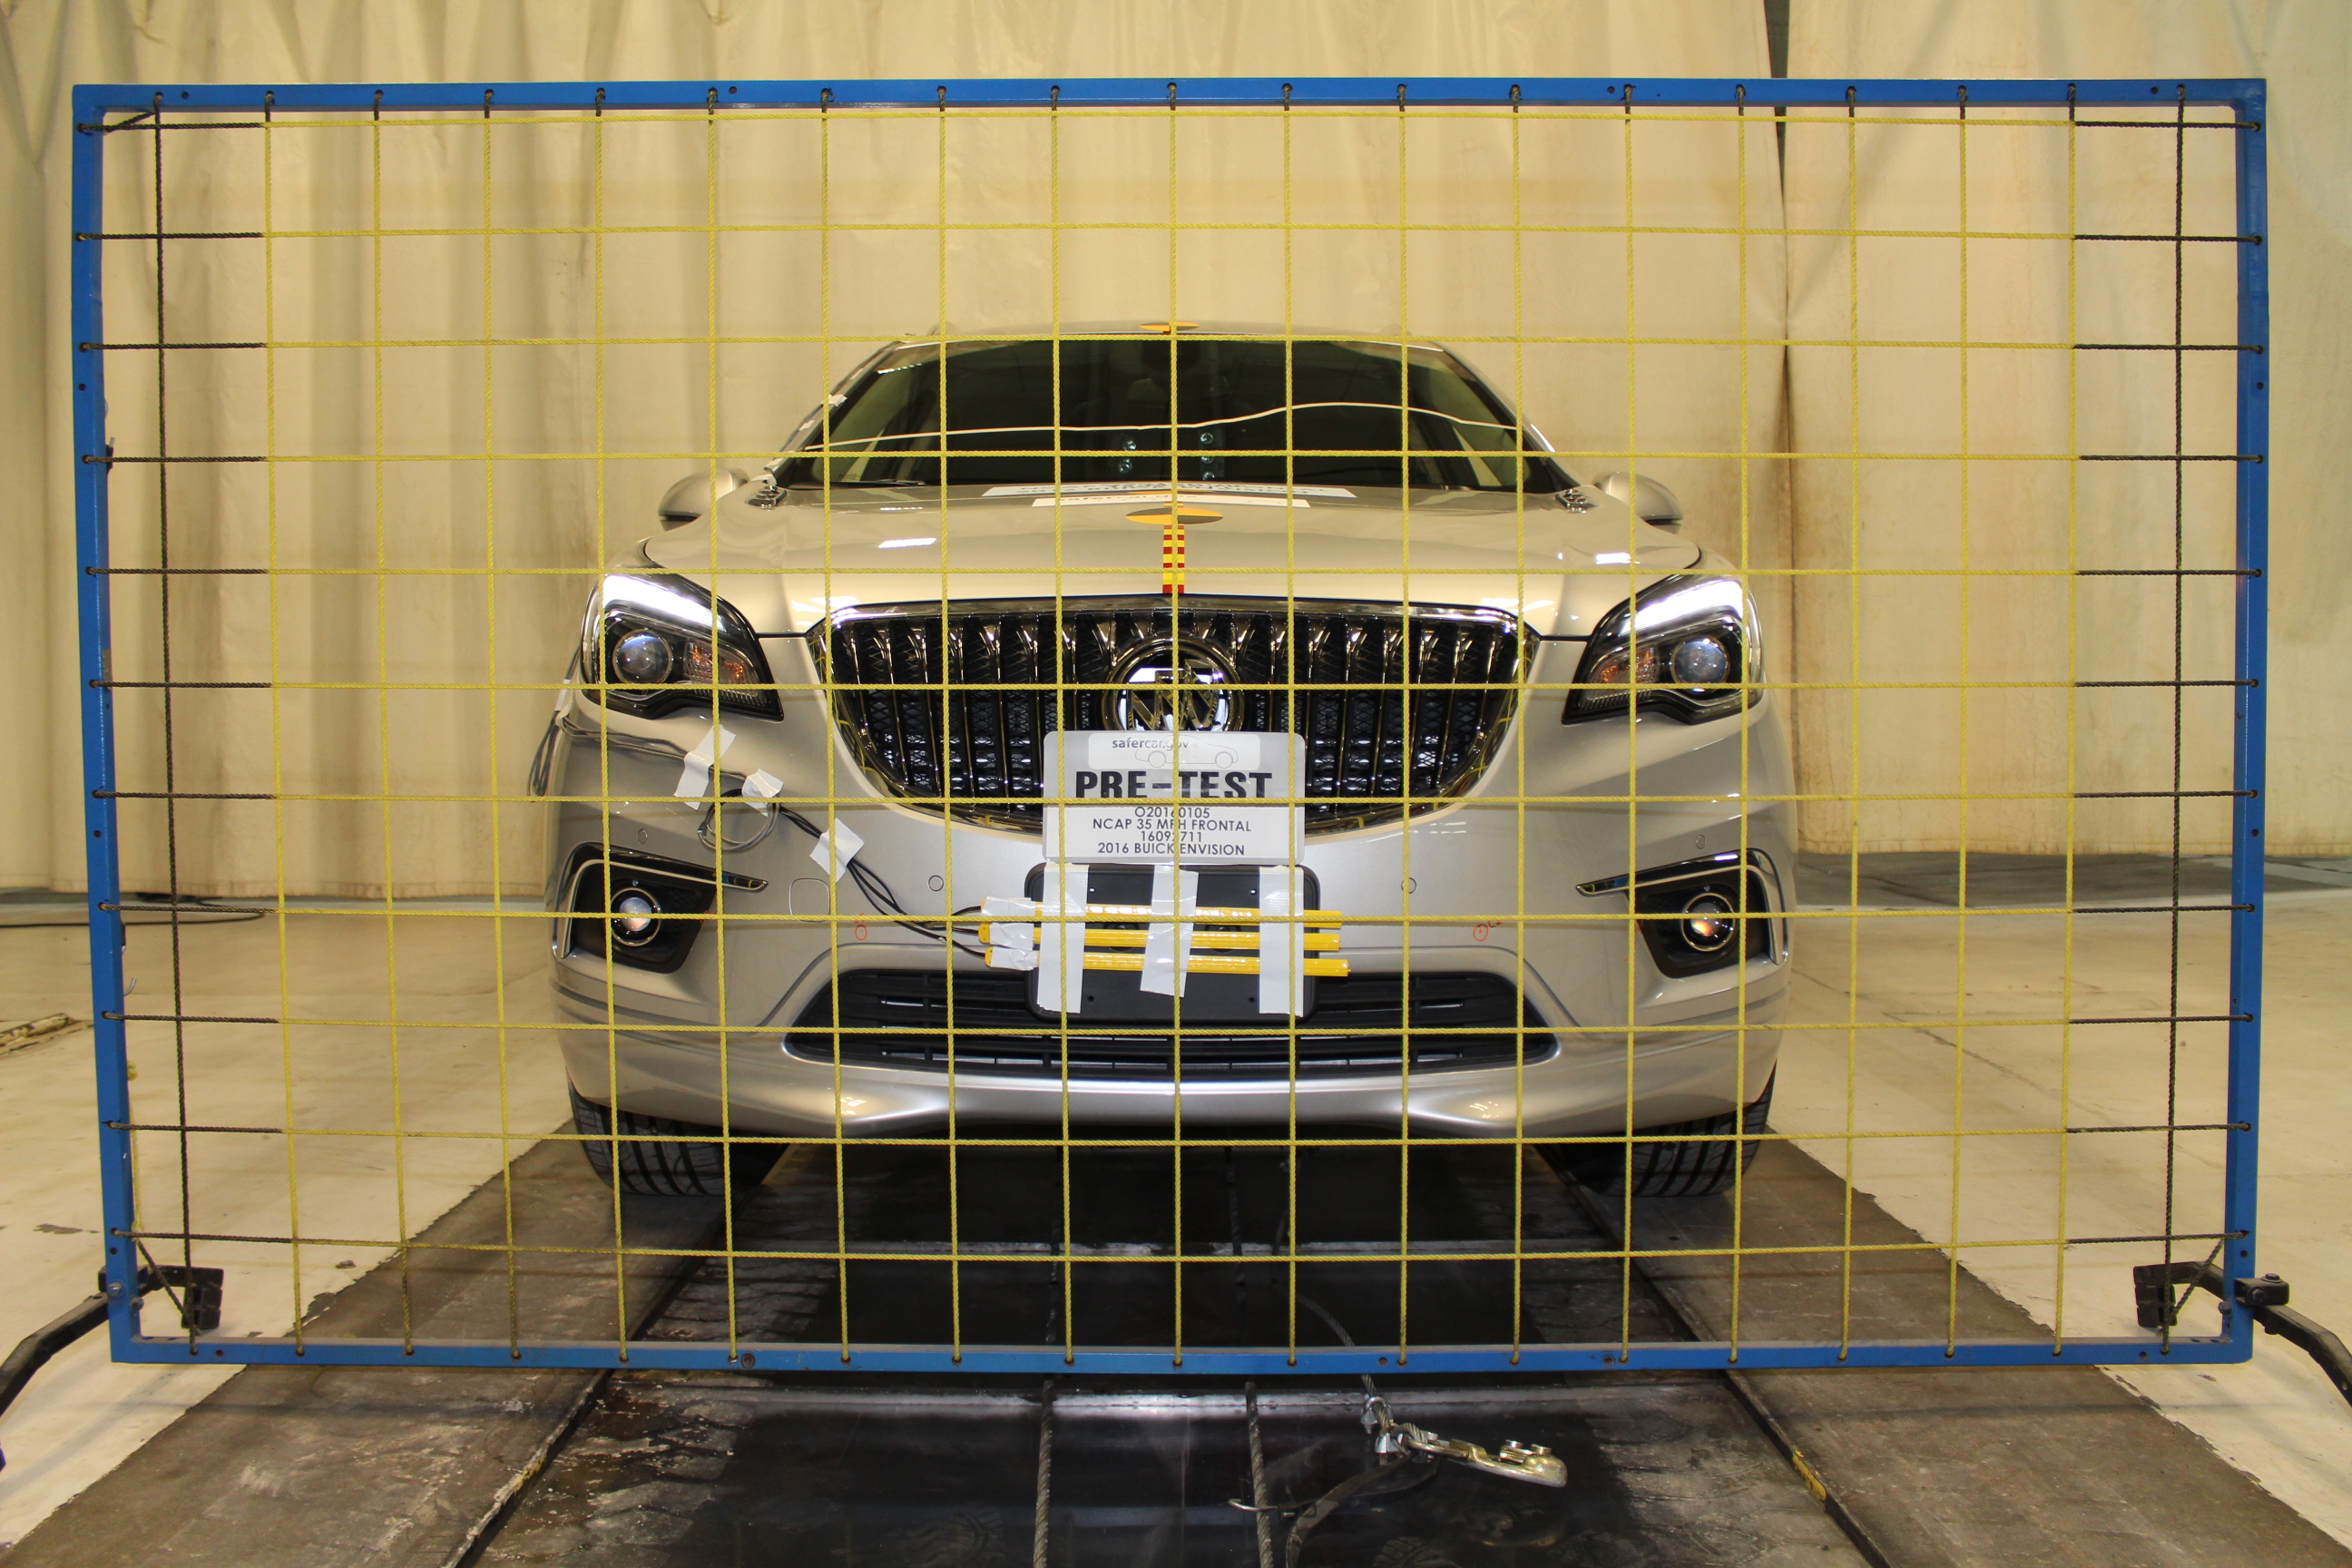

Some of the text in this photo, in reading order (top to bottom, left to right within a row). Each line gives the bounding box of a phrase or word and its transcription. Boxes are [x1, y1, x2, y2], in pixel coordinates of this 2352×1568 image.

[1076, 771, 1272, 799] PRE-TEST
[1093, 818, 1132, 829] NCAP
[1136, 818, 1152, 829] 35
[1191, 819, 1251, 832] FRONTAL
[1141, 830, 1202, 843] 1609711
[1098, 842, 1245, 856] 2016 BUICK ENVISION
